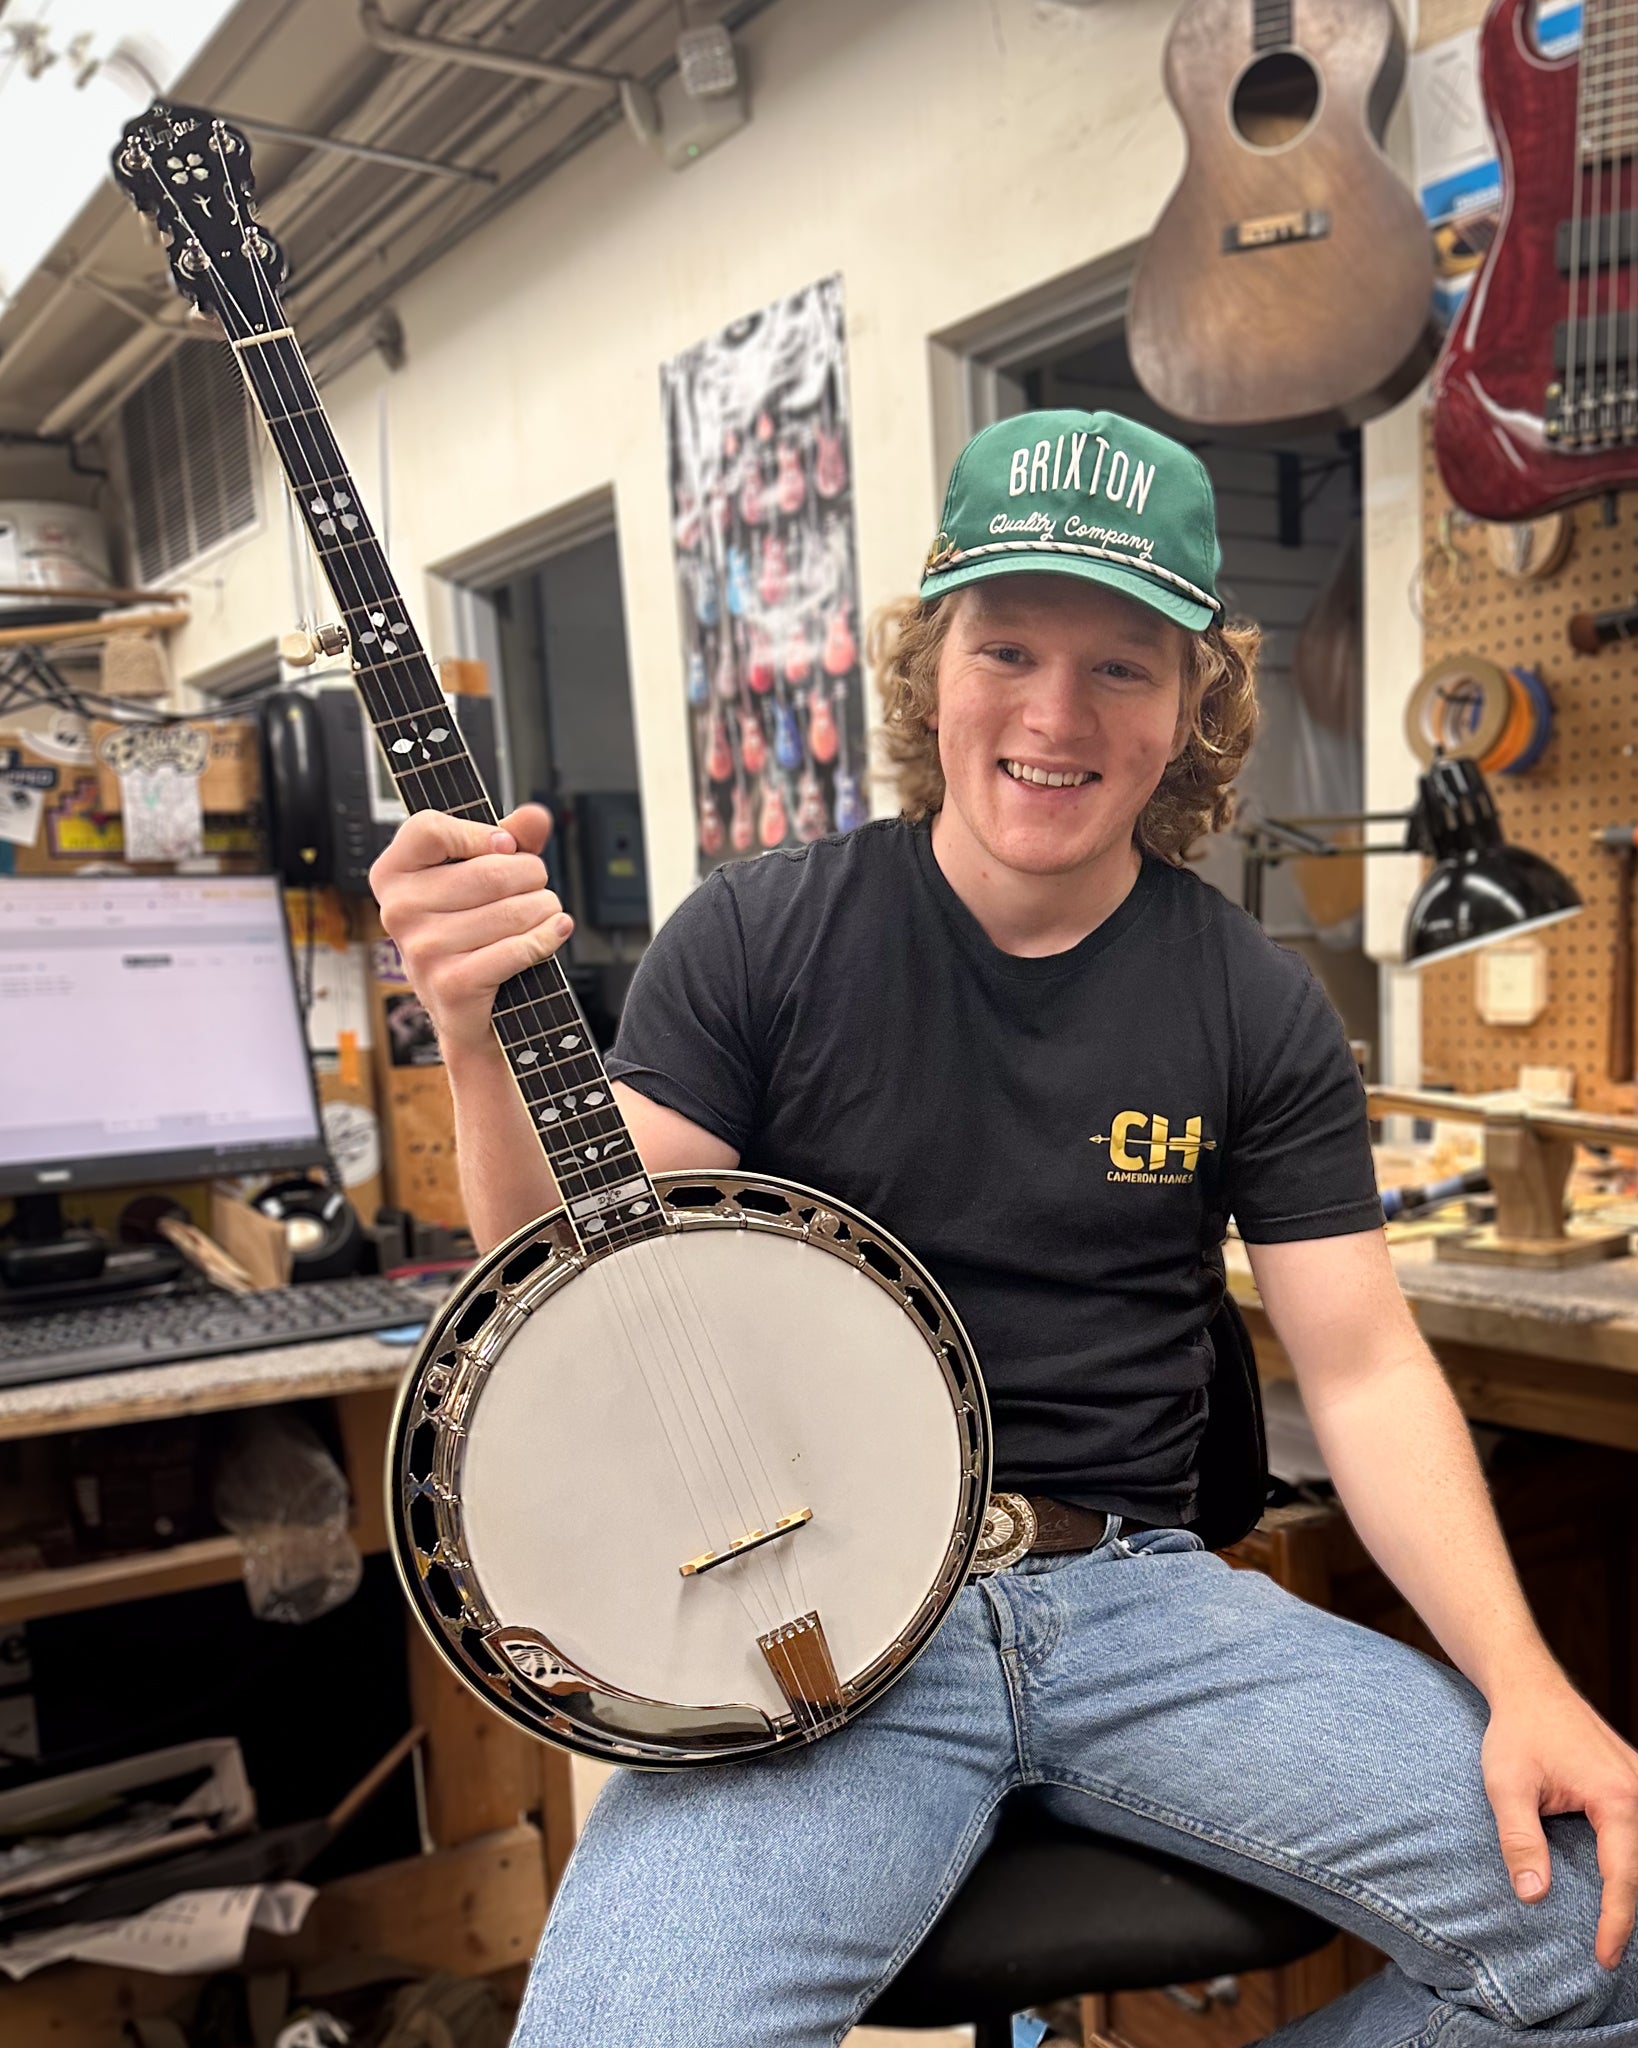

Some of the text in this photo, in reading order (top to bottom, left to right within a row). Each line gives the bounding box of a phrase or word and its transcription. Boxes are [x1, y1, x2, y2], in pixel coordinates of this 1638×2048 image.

[1009, 432, 1156, 515] BRIXTON
[989, 511, 1155, 560] Quality Company
[1110, 1110, 1202, 1172] CH
[1106, 1171, 1194, 1184] CAMERON HANES
